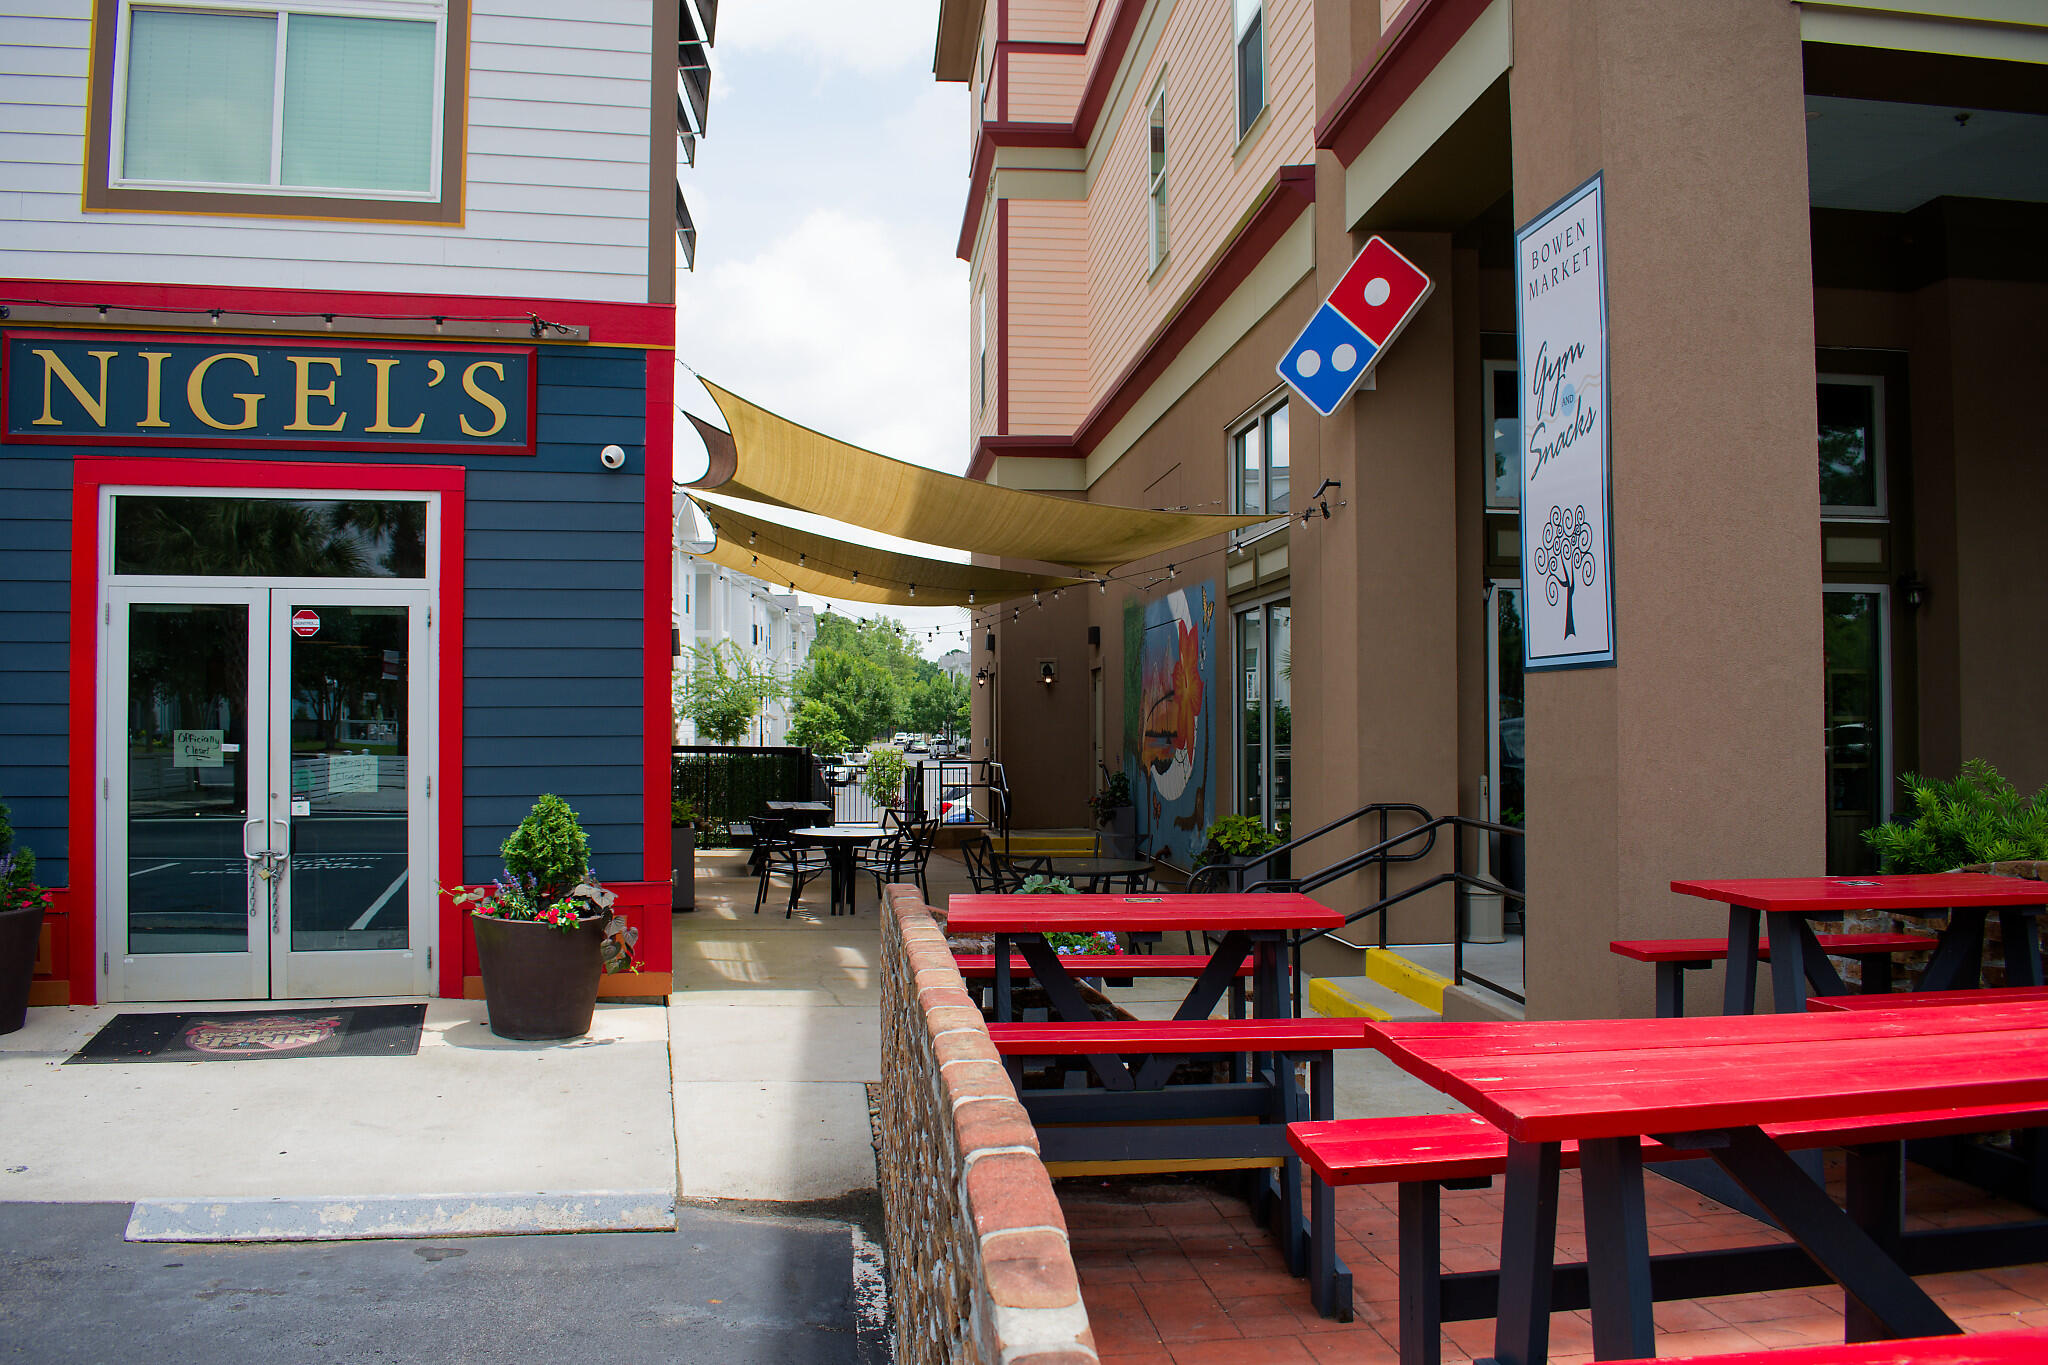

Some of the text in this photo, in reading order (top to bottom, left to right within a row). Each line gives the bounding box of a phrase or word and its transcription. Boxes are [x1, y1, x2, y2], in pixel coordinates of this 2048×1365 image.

[1531, 218, 1585, 270] BOWEN
[1529, 246, 1591, 301] MARKET
[32, 349, 508, 437] NIGEL'S
[1533, 340, 1585, 421] Gym
[1561, 394, 1574, 407] AND
[1530, 394, 1597, 481] Snacks
[178, 732, 221, 749] Officially
